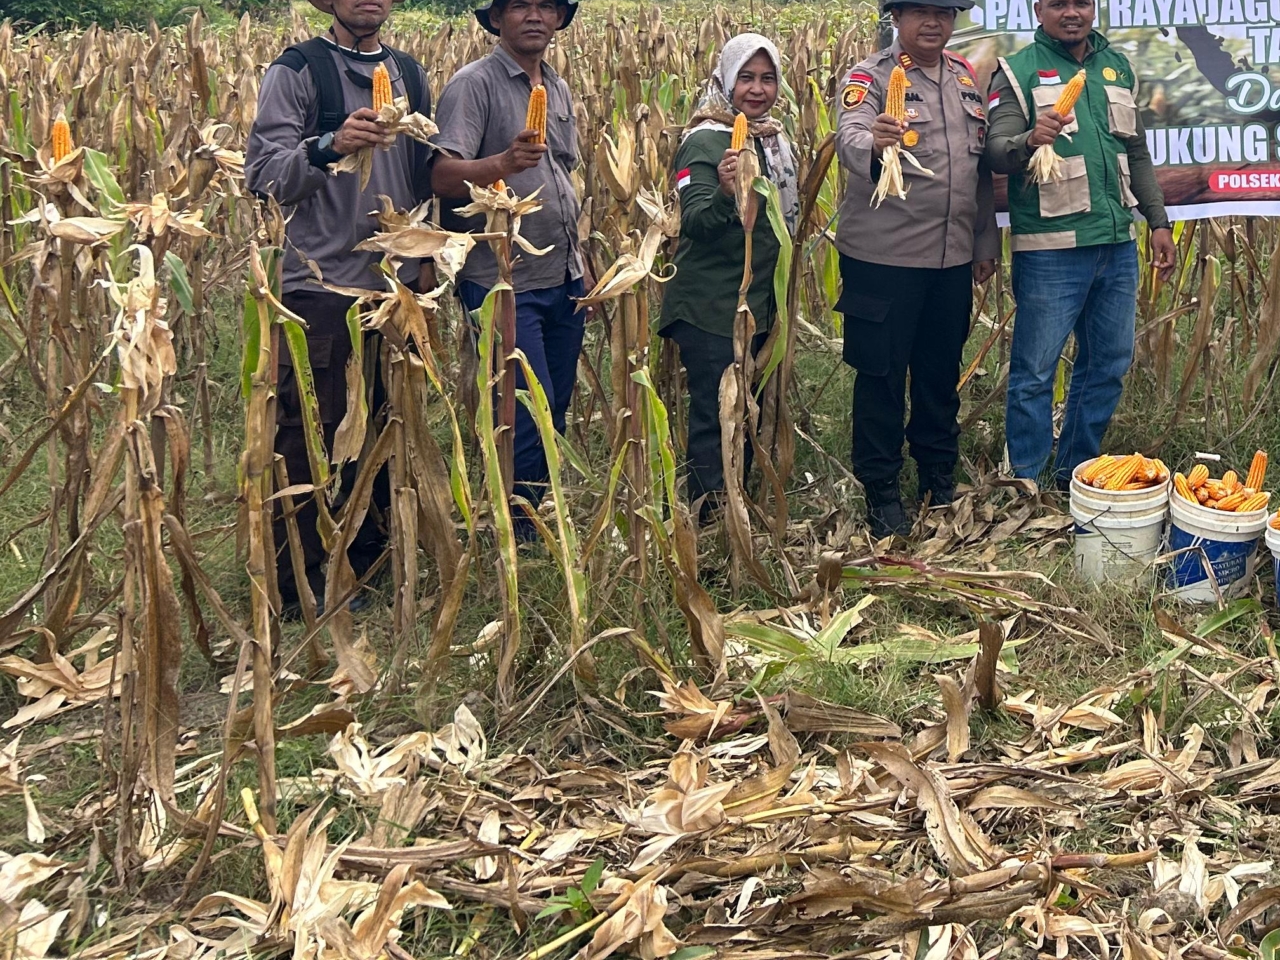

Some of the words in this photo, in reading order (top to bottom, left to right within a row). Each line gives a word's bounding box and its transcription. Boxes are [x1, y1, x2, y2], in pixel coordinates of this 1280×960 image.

[1145, 123, 1269, 167] UKUNG
[1212, 557, 1243, 570] NATURAL
[1217, 565, 1240, 577] MICRO
